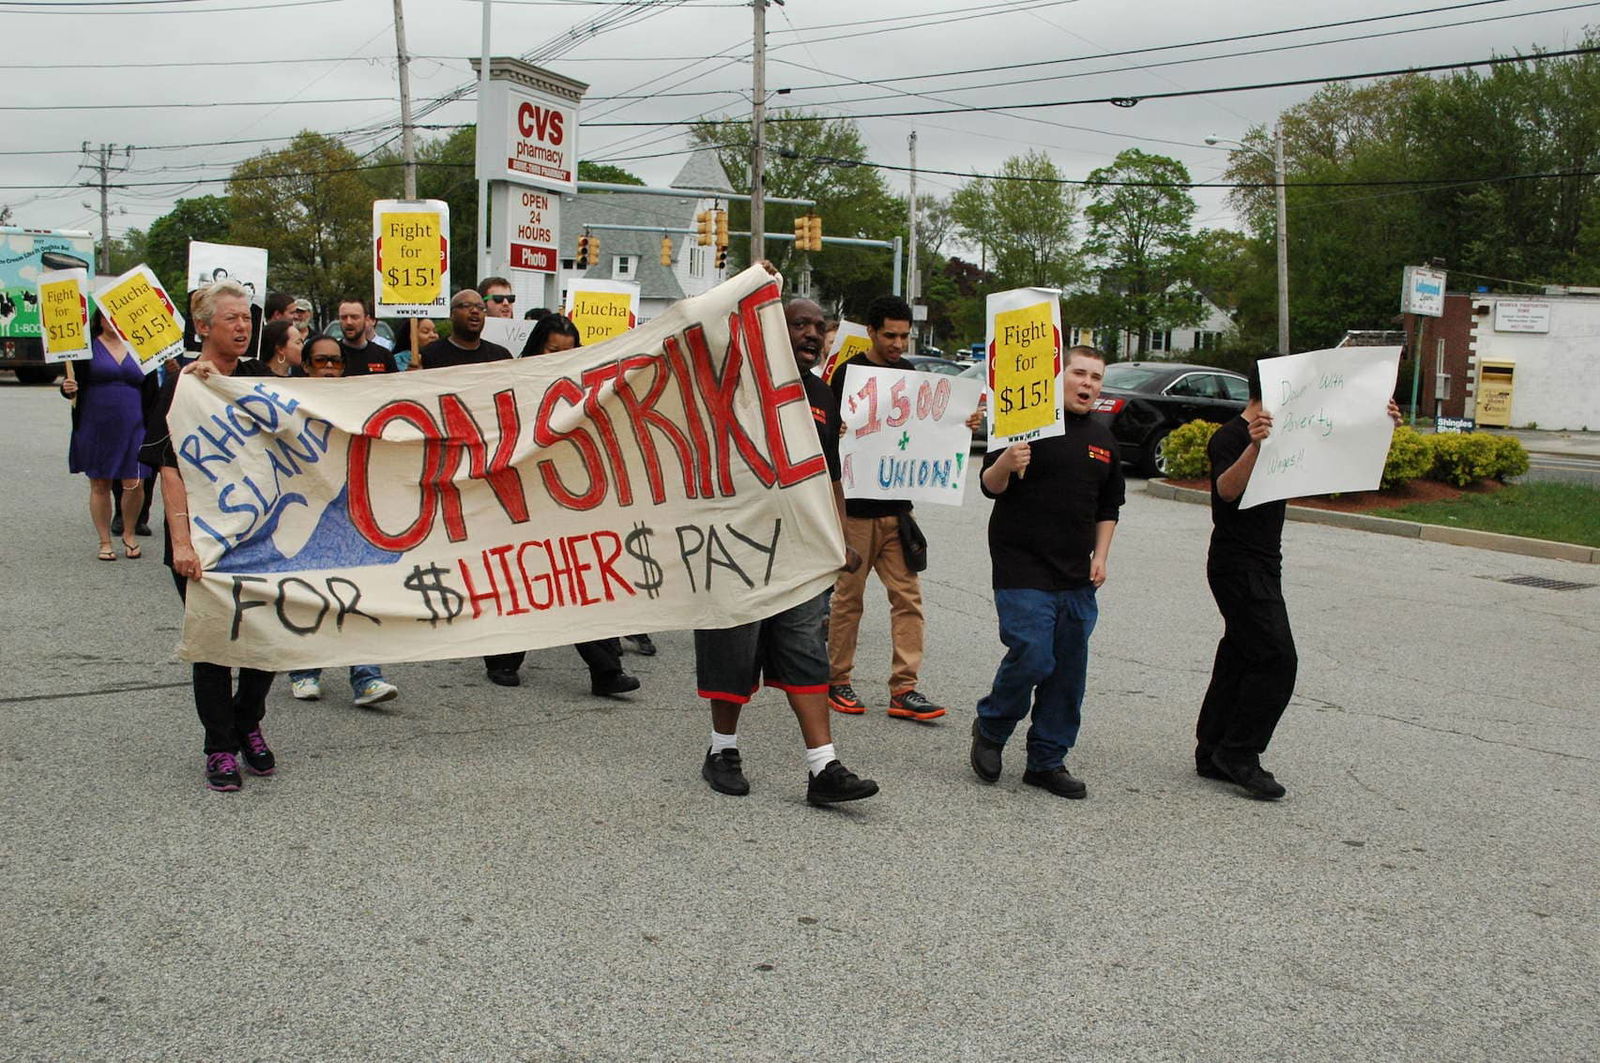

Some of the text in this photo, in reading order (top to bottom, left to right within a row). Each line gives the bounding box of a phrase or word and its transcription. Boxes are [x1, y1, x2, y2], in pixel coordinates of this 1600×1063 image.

[518, 102, 563, 146] CVS
[517, 139, 563, 168] pharmacy
[522, 193, 548, 211] OPEN
[530, 211, 541, 224] 24
[390, 223, 432, 241] Fight
[518, 225, 551, 242] HOURS
[400, 245, 422, 258] for
[522, 248, 547, 267] Photo
[388, 267, 435, 288] $15!
[47, 288, 74, 304] Fight
[107, 283, 150, 315] ¡Lucha
[54, 306, 70, 317] for
[127, 303, 149, 324] por
[575, 301, 627, 318] ¡Lucha
[49, 322, 80, 341] $15!
[131, 314, 172, 346] $15!
[505, 327, 527, 342] We
[587, 325, 612, 338] por
[1004, 320, 1047, 348] Fight
[1015, 354, 1038, 372] for
[1000, 379, 1048, 415] $15!
[346, 281, 827, 552] ON STRIKE
[1437, 418, 1473, 428] Shingles
[178, 383, 300, 483] RHODE
[878, 452, 965, 491] UNION!
[192, 416, 335, 551] ISLAND
[230, 574, 382, 641] FOR
[675, 518, 782, 593] PAY
